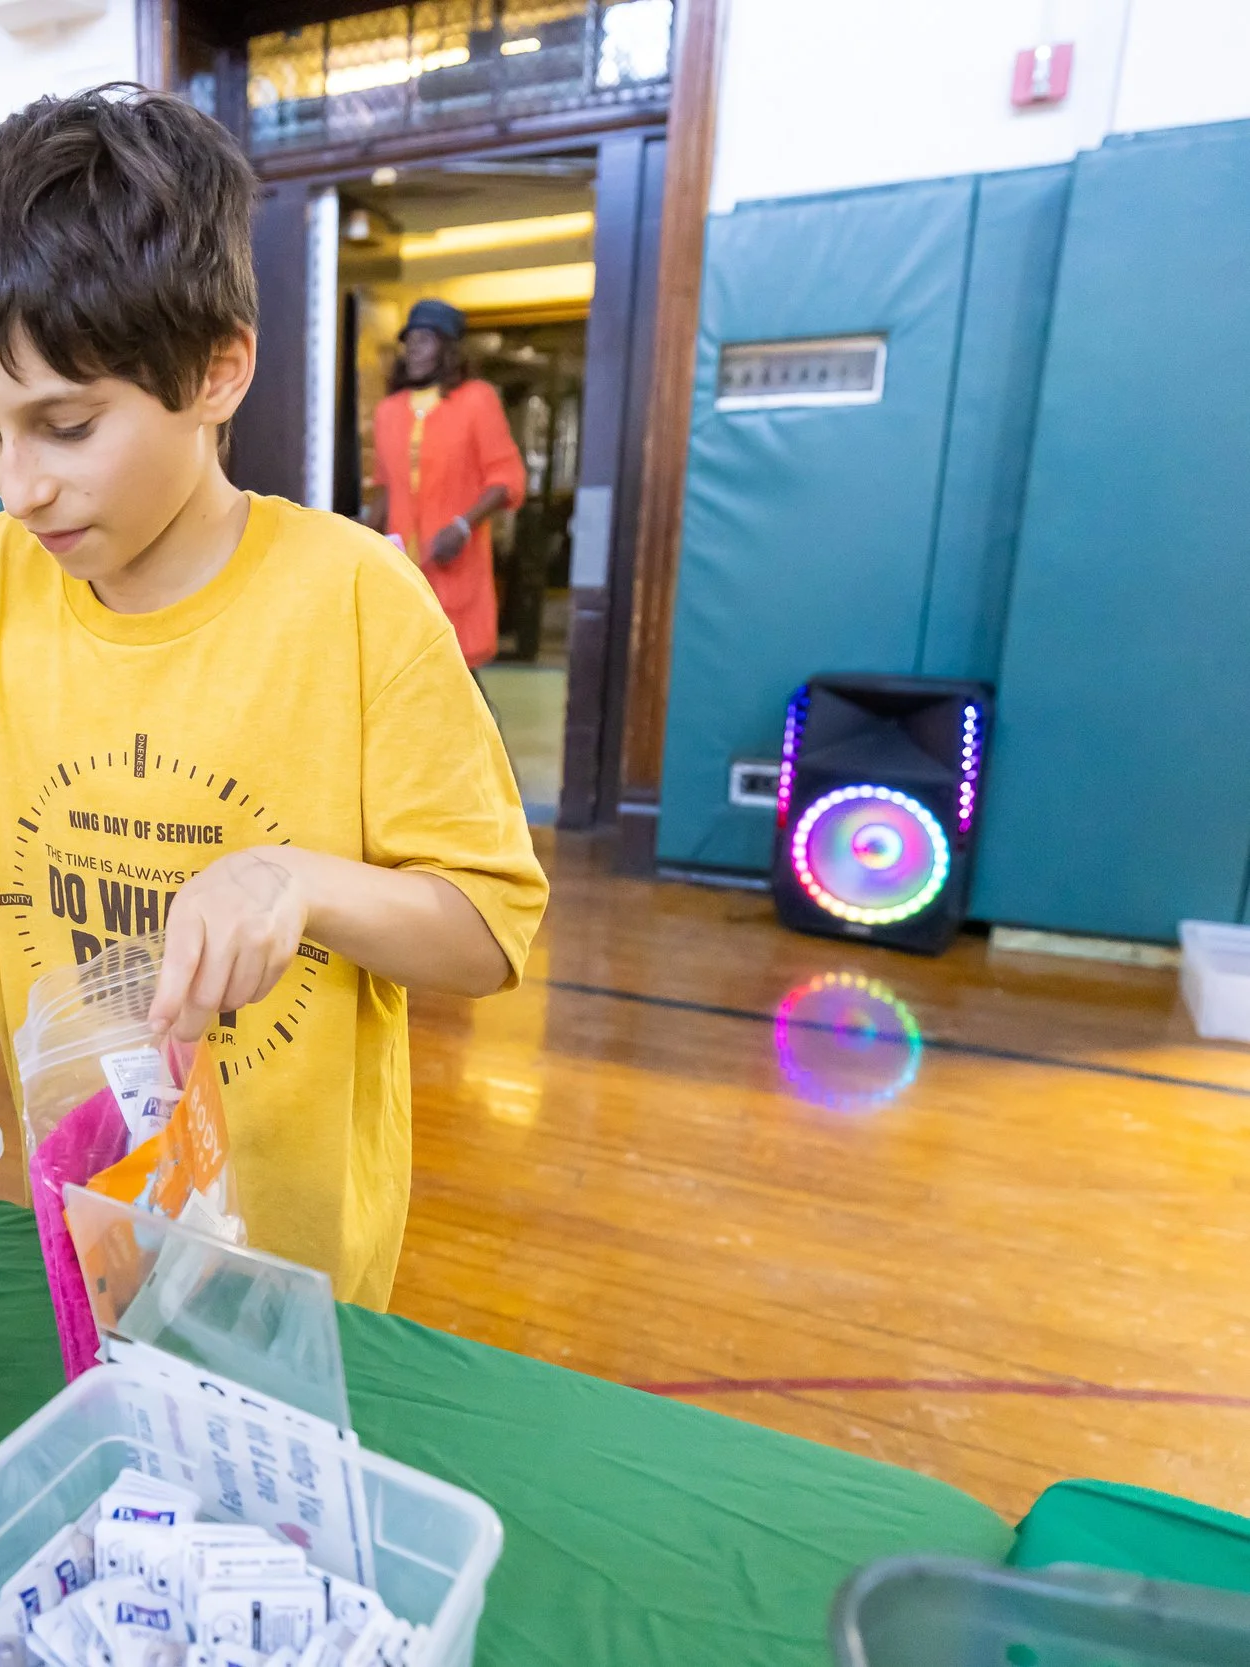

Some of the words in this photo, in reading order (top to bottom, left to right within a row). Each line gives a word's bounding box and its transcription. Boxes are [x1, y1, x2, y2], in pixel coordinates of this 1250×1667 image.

[136, 734, 145, 778] ONENESS
[69, 809, 99, 832] KING
[104, 815, 129, 837] DAY
[134, 820, 151, 840] OF
[156, 822, 223, 844] SERVICE
[45, 843, 63, 863] THE
[65, 852, 97, 870] TIME
[100, 859, 113, 873] IS
[117, 862, 185, 884] ALWAYS
[0, 895, 31, 905] UNITY
[48, 864, 87, 925] DO
[297, 944, 329, 964] RUTH
